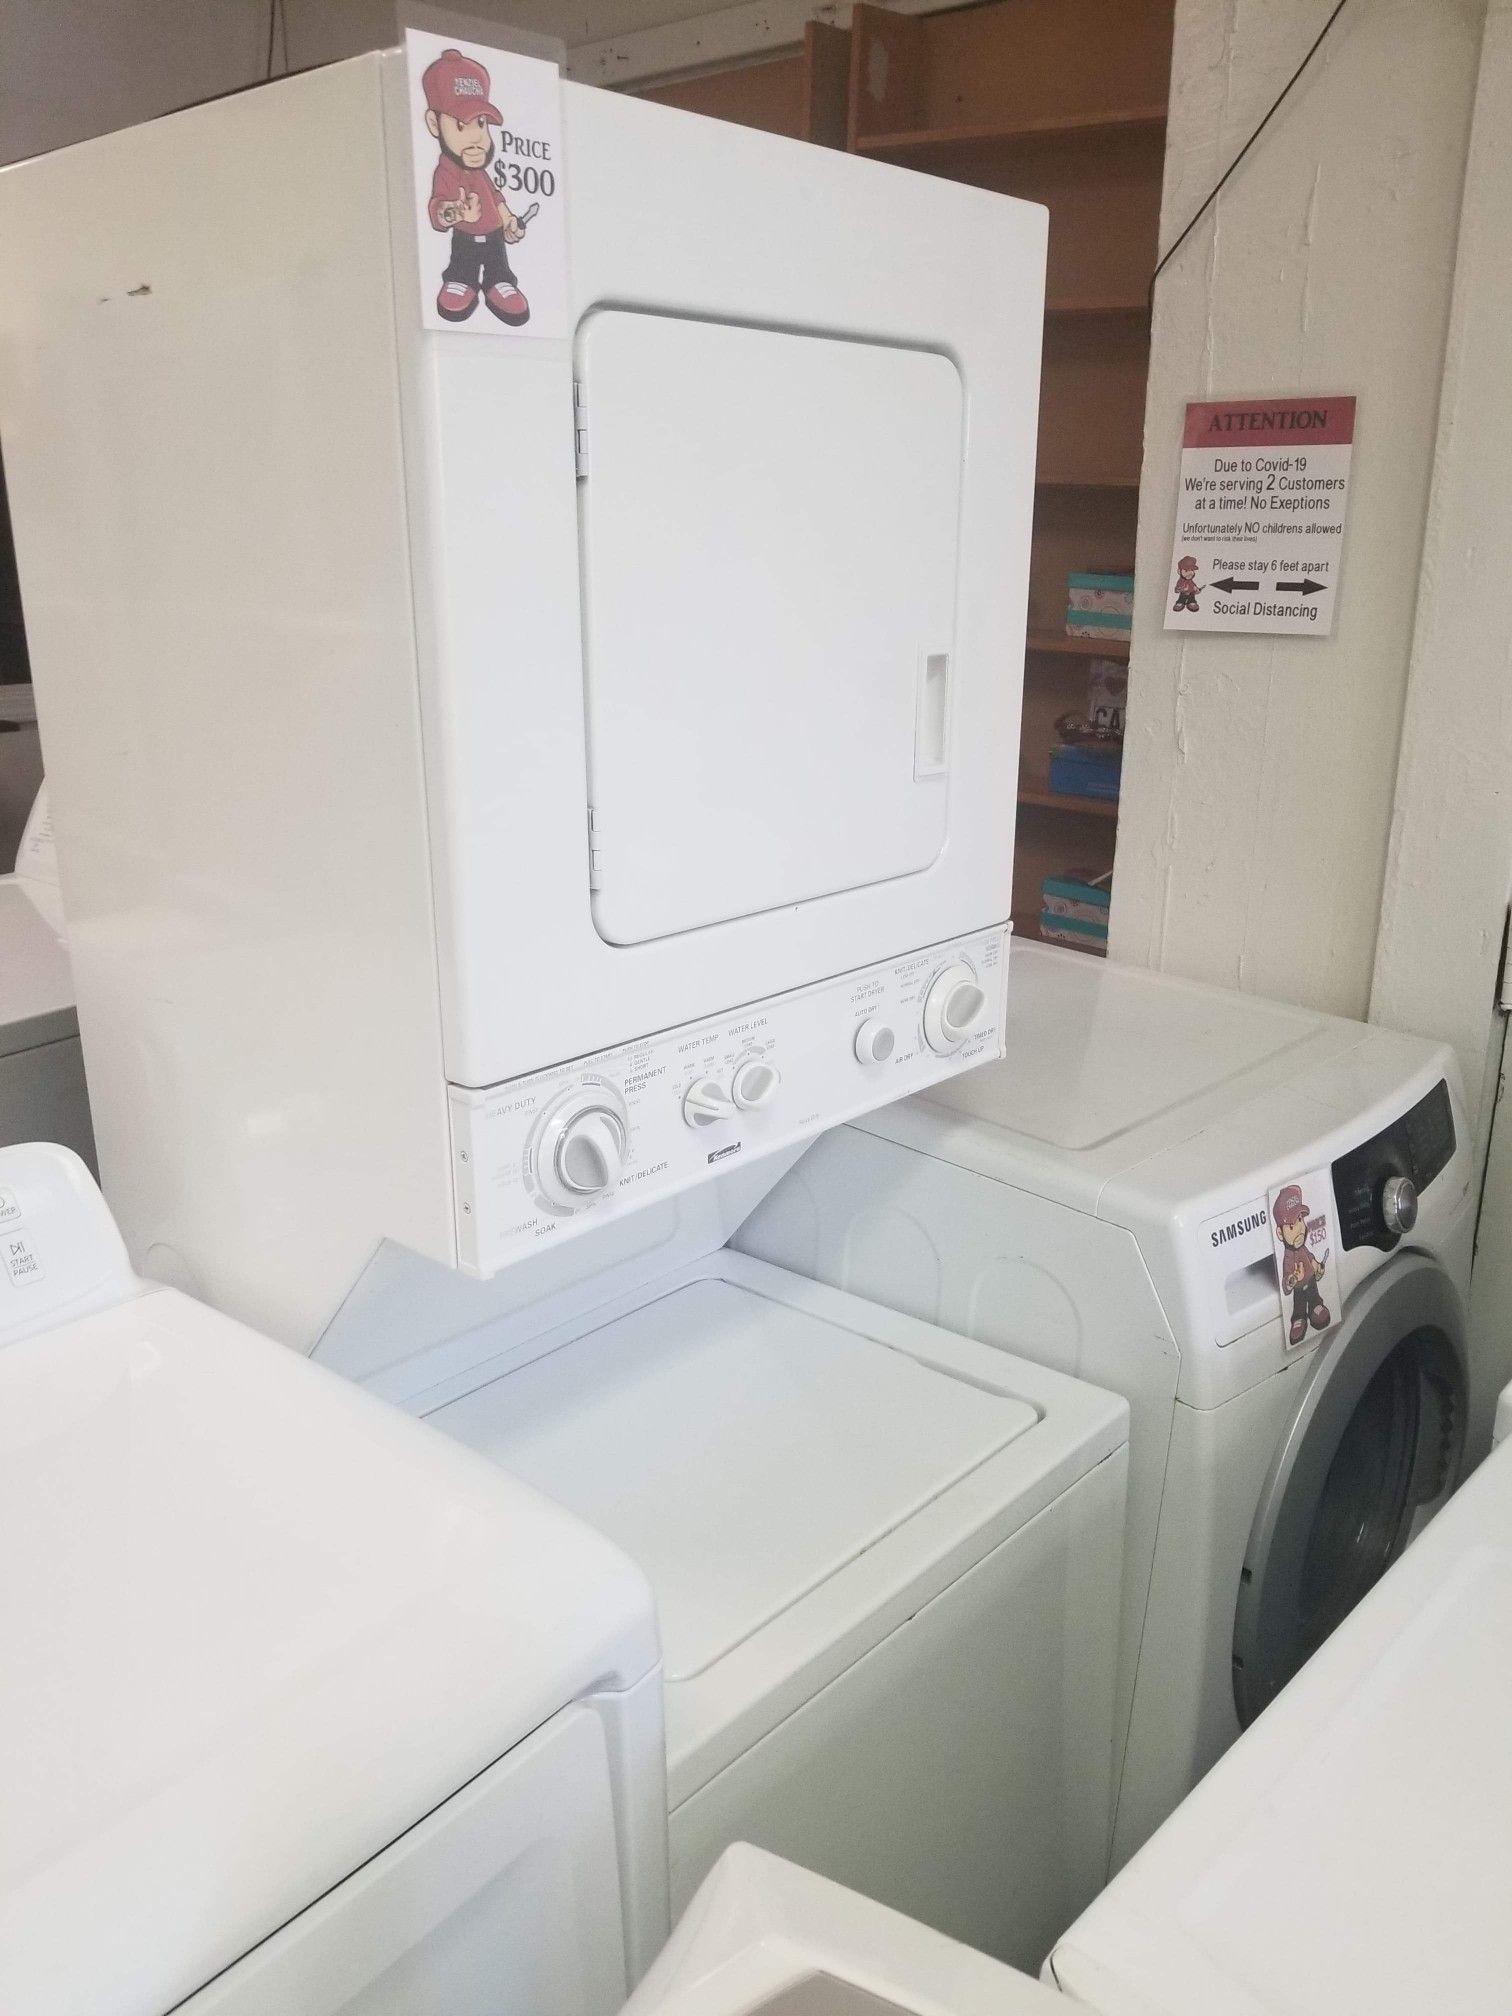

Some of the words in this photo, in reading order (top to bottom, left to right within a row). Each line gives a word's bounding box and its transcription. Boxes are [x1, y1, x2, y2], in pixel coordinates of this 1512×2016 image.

[494, 158, 555, 197] $300
[1209, 410, 1328, 432] ATTENTION
[1214, 458, 1238, 473] Due
[1241, 458, 1252, 472] to
[1255, 457, 1307, 472] Covid-19
[1184, 478, 1217, 492] We're
[1219, 477, 1263, 494] serving
[1266, 474, 1276, 491] 2
[1278, 477, 1345, 490] Customers
[1195, 497, 1207, 510] at
[1208, 499, 1216, 510] a
[1219, 496, 1247, 510] time!
[1250, 496, 1267, 510] No
[1270, 496, 1330, 512] Exeptions
[1182, 523, 1243, 536] Unfortunately
[1244, 522, 1260, 534] NO
[1262, 523, 1303, 534] childrens
[1305, 522, 1342, 534] allowed
[1213, 559, 1246, 571] Please
[1248, 560, 1269, 574] stay
[1270, 560, 1277, 571] 6
[1279, 560, 1300, 572] feet
[1301, 562, 1329, 574] apart
[1213, 601, 1250, 615] Social
[1253, 602, 1318, 620] Distancing
[728, 1023, 749, 1037] WATER
[750, 1017, 768, 1030] LEVEL
[678, 1040, 700, 1053] WATER
[701, 1034, 719, 1046] TEMP
[624, 1066, 667, 1086] PERMANENT
[624, 1081, 647, 1095] PRESS
[515, 1097, 536, 1111] DUTY
[619, 1161, 669, 1187] KNIT/DELICATE
[535, 1222, 556, 1237] SOAK
[1211, 1210, 1267, 1247] SAMSUNG
[10, 1254, 32, 1267] START
[13, 1263, 38, 1275] PAUSE
